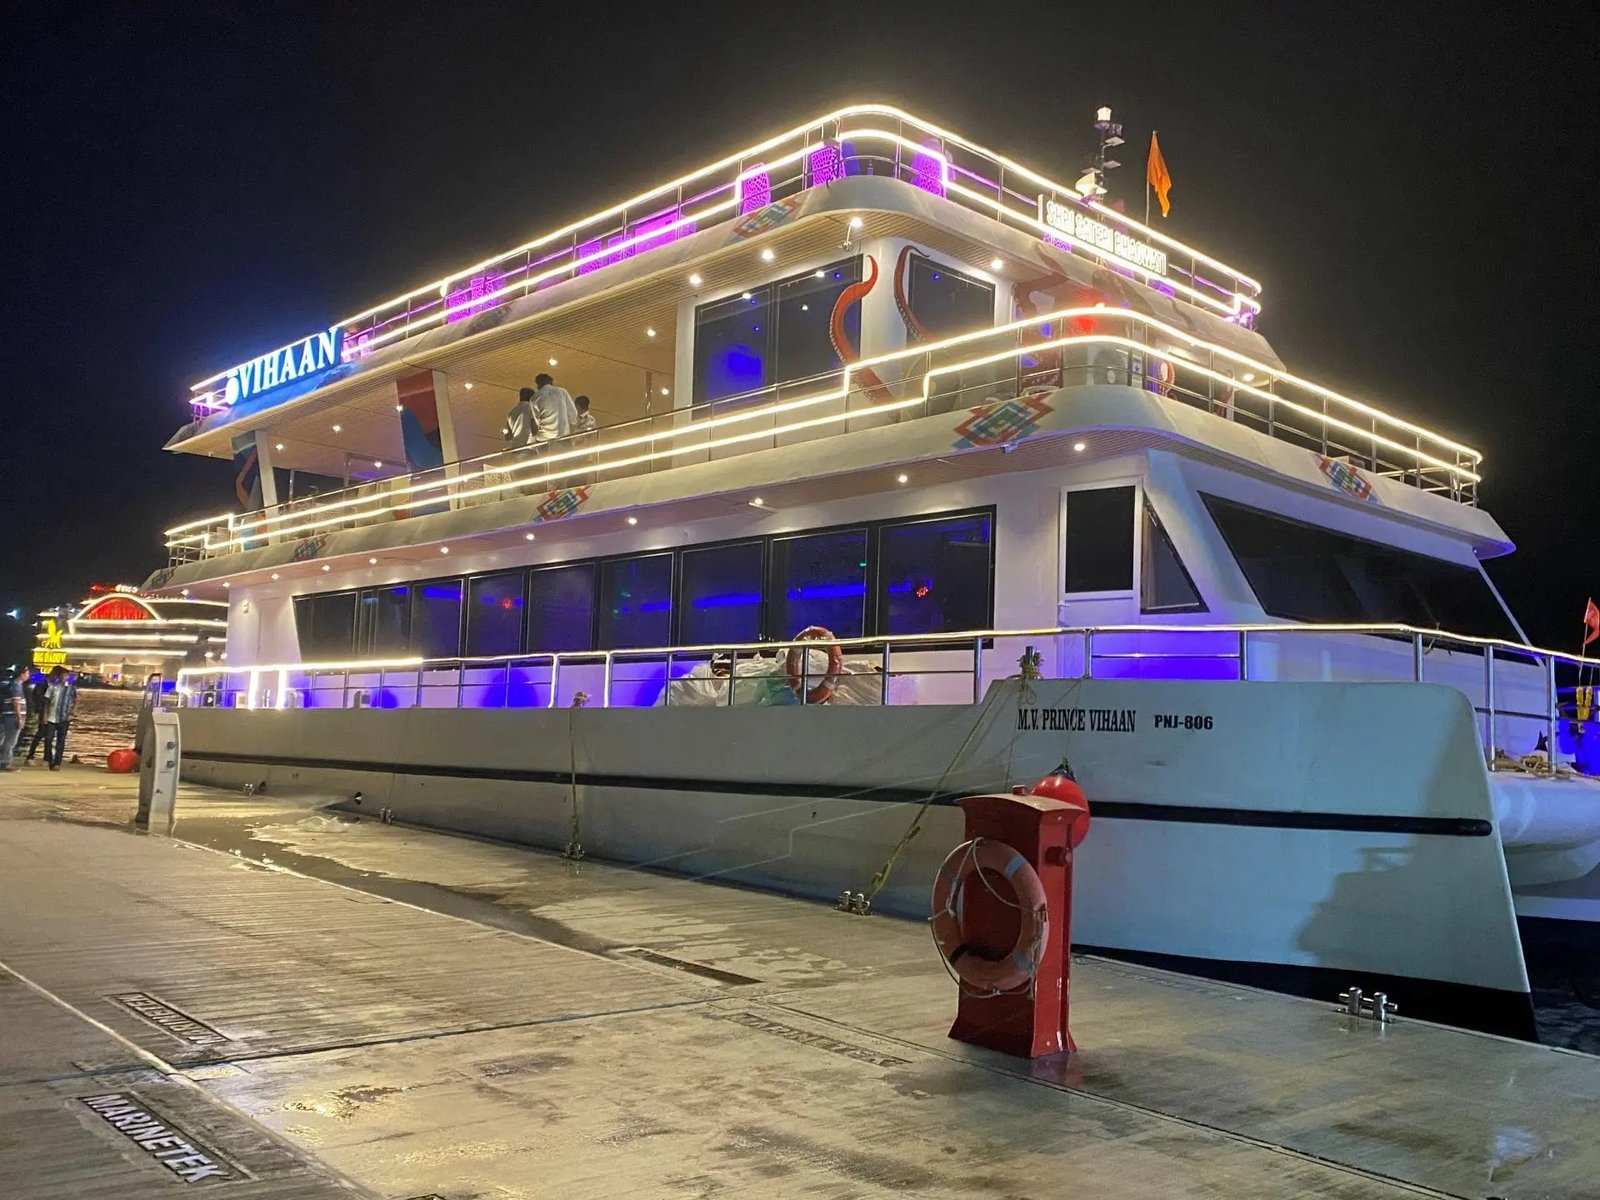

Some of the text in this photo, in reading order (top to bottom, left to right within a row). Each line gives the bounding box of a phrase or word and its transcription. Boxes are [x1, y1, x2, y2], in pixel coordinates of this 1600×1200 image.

[237, 327, 339, 398] VIHAAN
[1018, 708, 1214, 732] M.V. PRINCE VIHAAN PNJ-806
[82, 1094, 230, 1183] MARINETEK
